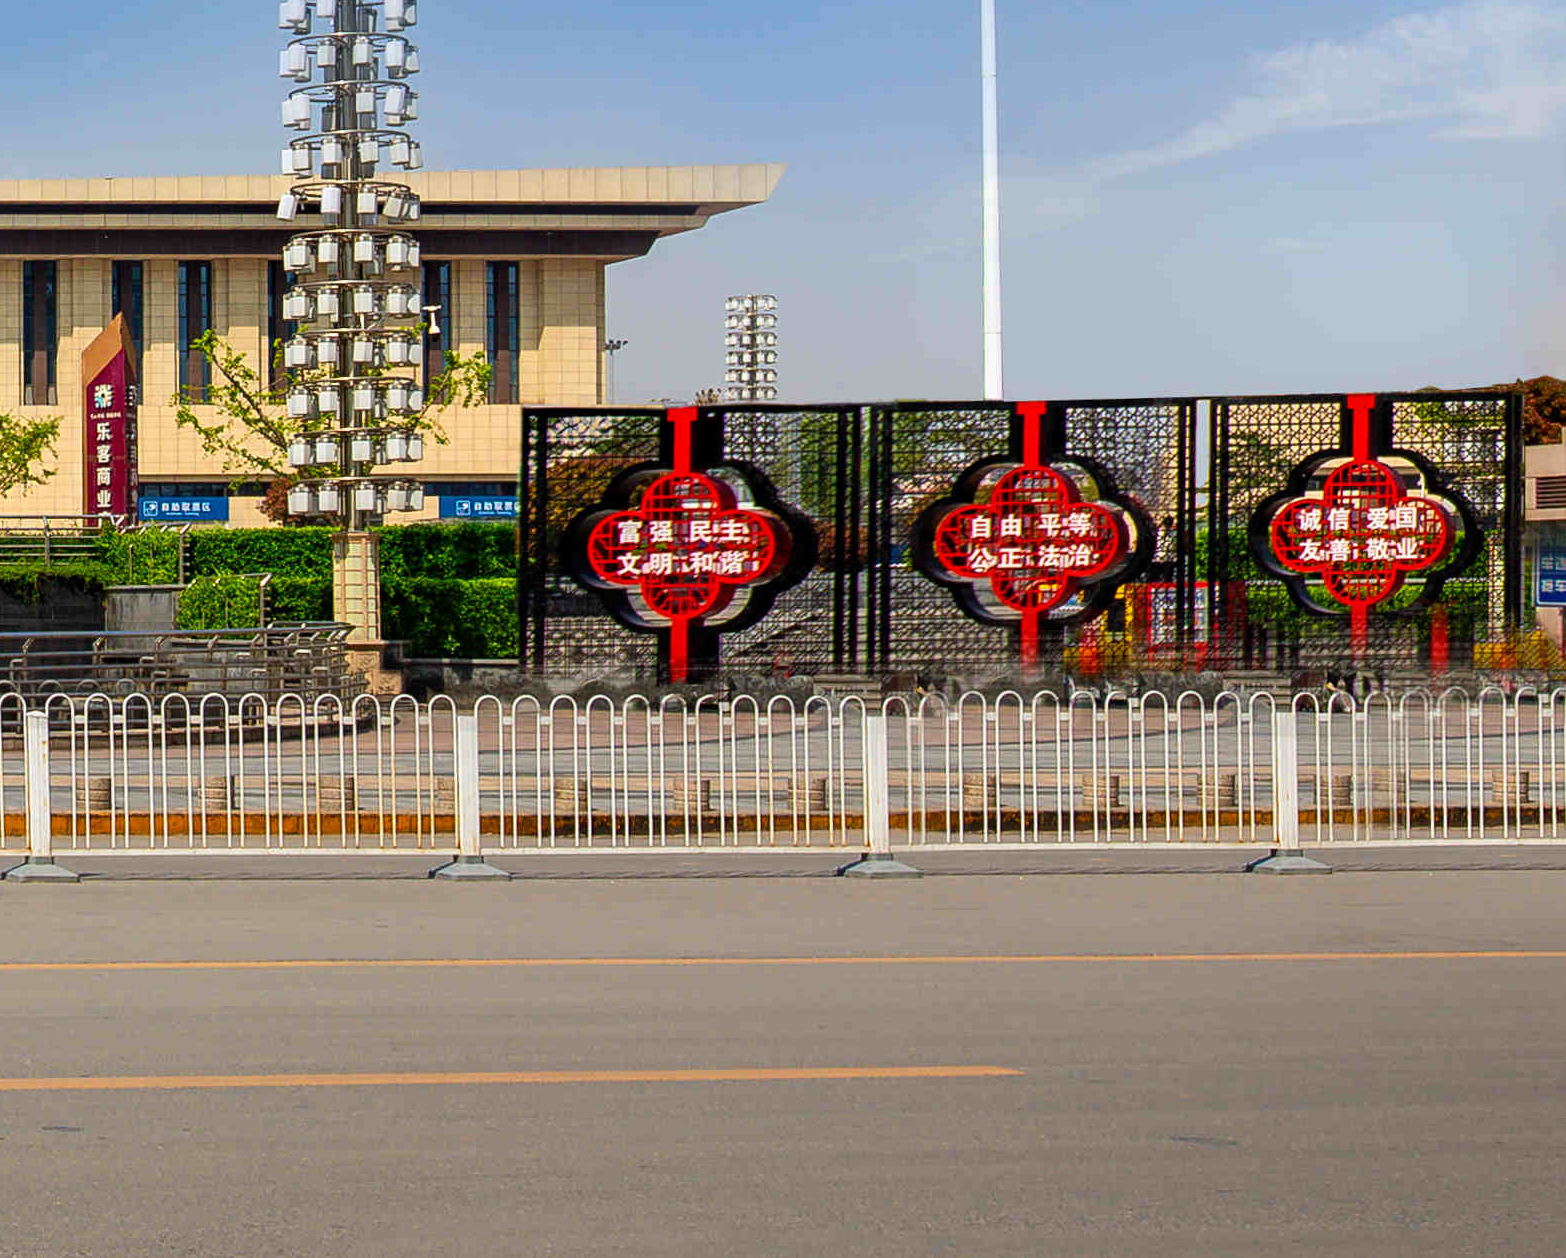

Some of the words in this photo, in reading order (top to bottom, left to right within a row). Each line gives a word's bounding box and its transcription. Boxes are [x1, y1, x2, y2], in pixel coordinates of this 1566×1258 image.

[971, 514, 1022, 539] 自由
[1038, 512, 1092, 537] 平等
[1298, 507, 1350, 531] 诚信
[1367, 506, 1417, 530] 爱国
[618, 520, 674, 544] 富强
[689, 519, 745, 543] 民主
[968, 547, 1023, 573] 公正
[1038, 544, 1091, 568] 法治
[1298, 539, 1350, 562] 友善
[1365, 537, 1418, 561] 敬业
[618, 552, 674, 575] 文明
[688, 551, 746, 575] 和谐
